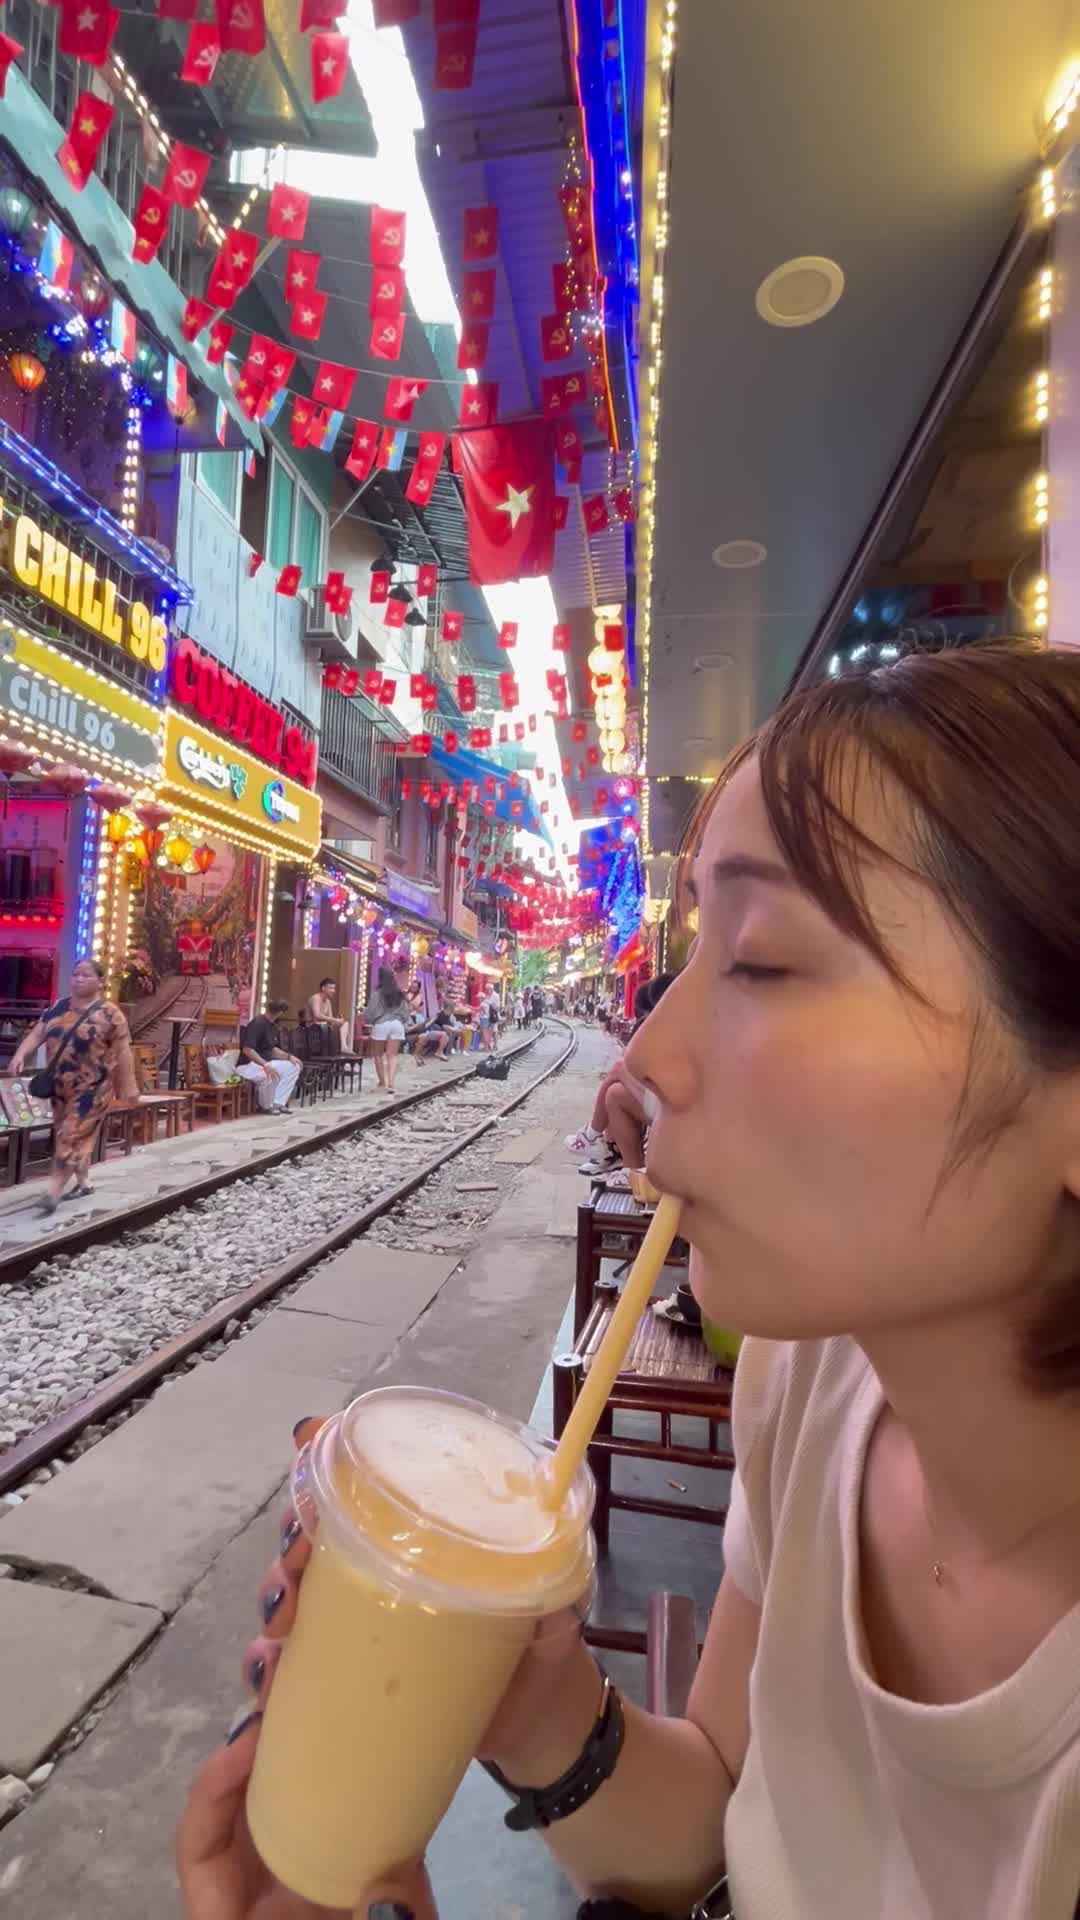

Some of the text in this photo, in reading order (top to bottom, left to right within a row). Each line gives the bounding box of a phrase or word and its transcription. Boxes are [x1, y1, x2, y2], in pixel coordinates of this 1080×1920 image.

[14, 515, 167, 672] CHILL 96
[10, 675, 116, 750] Chill 96
[285, 726, 316, 789] 94
